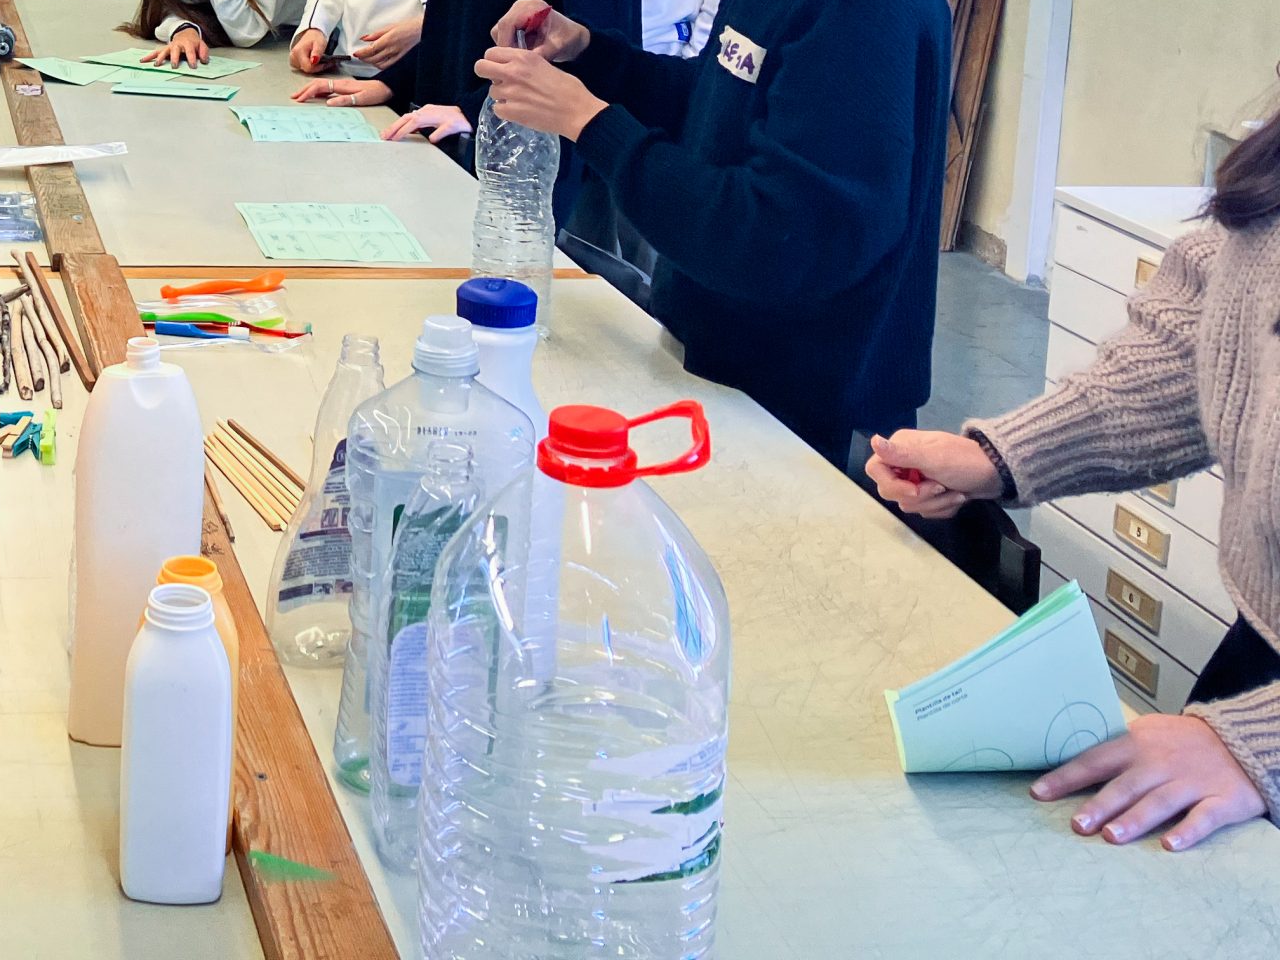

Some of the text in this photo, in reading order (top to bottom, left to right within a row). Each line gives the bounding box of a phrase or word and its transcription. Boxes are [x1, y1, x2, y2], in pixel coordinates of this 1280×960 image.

[1136, 526, 1142, 537] 5
[1128, 592, 1134, 603] 6
[1125, 654, 1130, 664] 7
